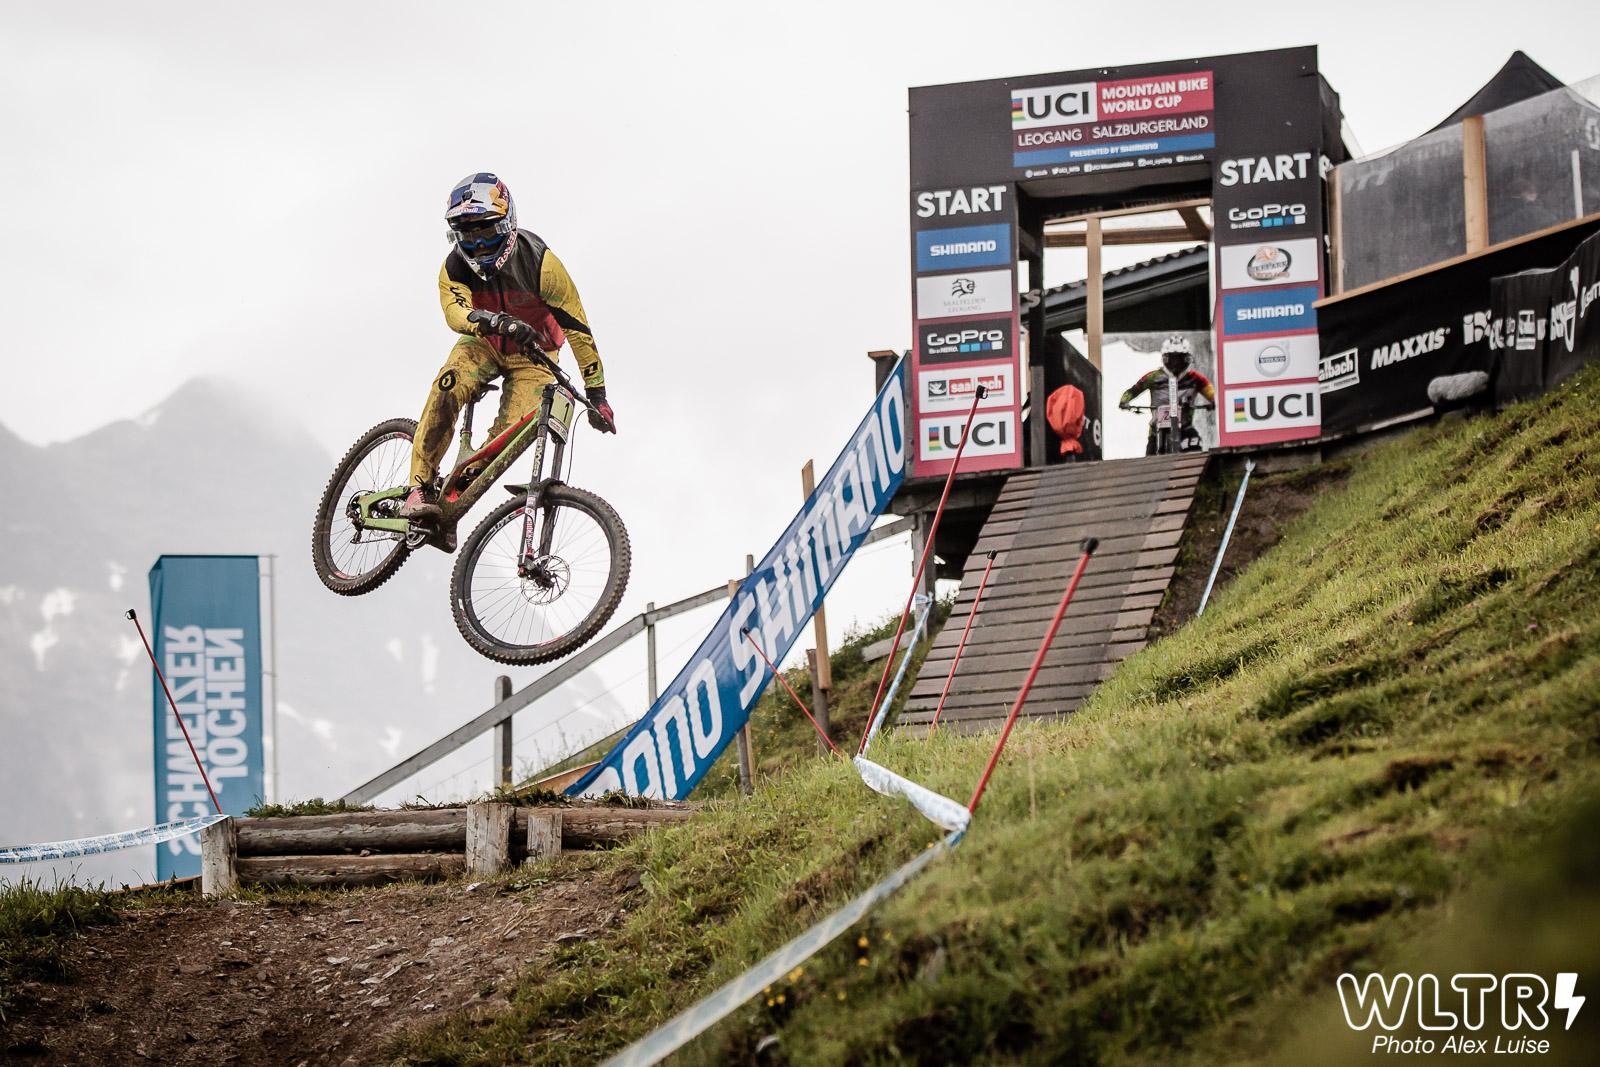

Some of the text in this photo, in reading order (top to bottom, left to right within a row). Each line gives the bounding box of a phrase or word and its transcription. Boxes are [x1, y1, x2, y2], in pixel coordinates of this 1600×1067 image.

[1101, 77, 1209, 100] MOUNTAIN BIKE
[1027, 91, 1090, 119] UCI
[1102, 95, 1183, 114] WORLD CUP
[1018, 116, 1209, 147] LEOGANG SALZBURGERLAND
[1069, 148, 1109, 158] PRESENTED
[1120, 142, 1159, 153] SHIMANO
[1219, 152, 1311, 187] START
[916, 185, 1007, 218] START
[1228, 203, 1306, 221] GoPro
[930, 239, 997, 257] SHIMANO
[943, 297, 987, 307] SAALFELDEN
[948, 305, 981, 314] LEOGANG
[1236, 304, 1304, 320] SHIMANO
[926, 329, 1003, 346] GoPro
[1370, 328, 1447, 370] MAXXIS
[1318, 354, 1354, 381] albach
[564, 402, 570, 423] 1
[1249, 392, 1314, 420] UCI
[943, 420, 1007, 450] UCI
[728, 374, 905, 711] SHIMANO
